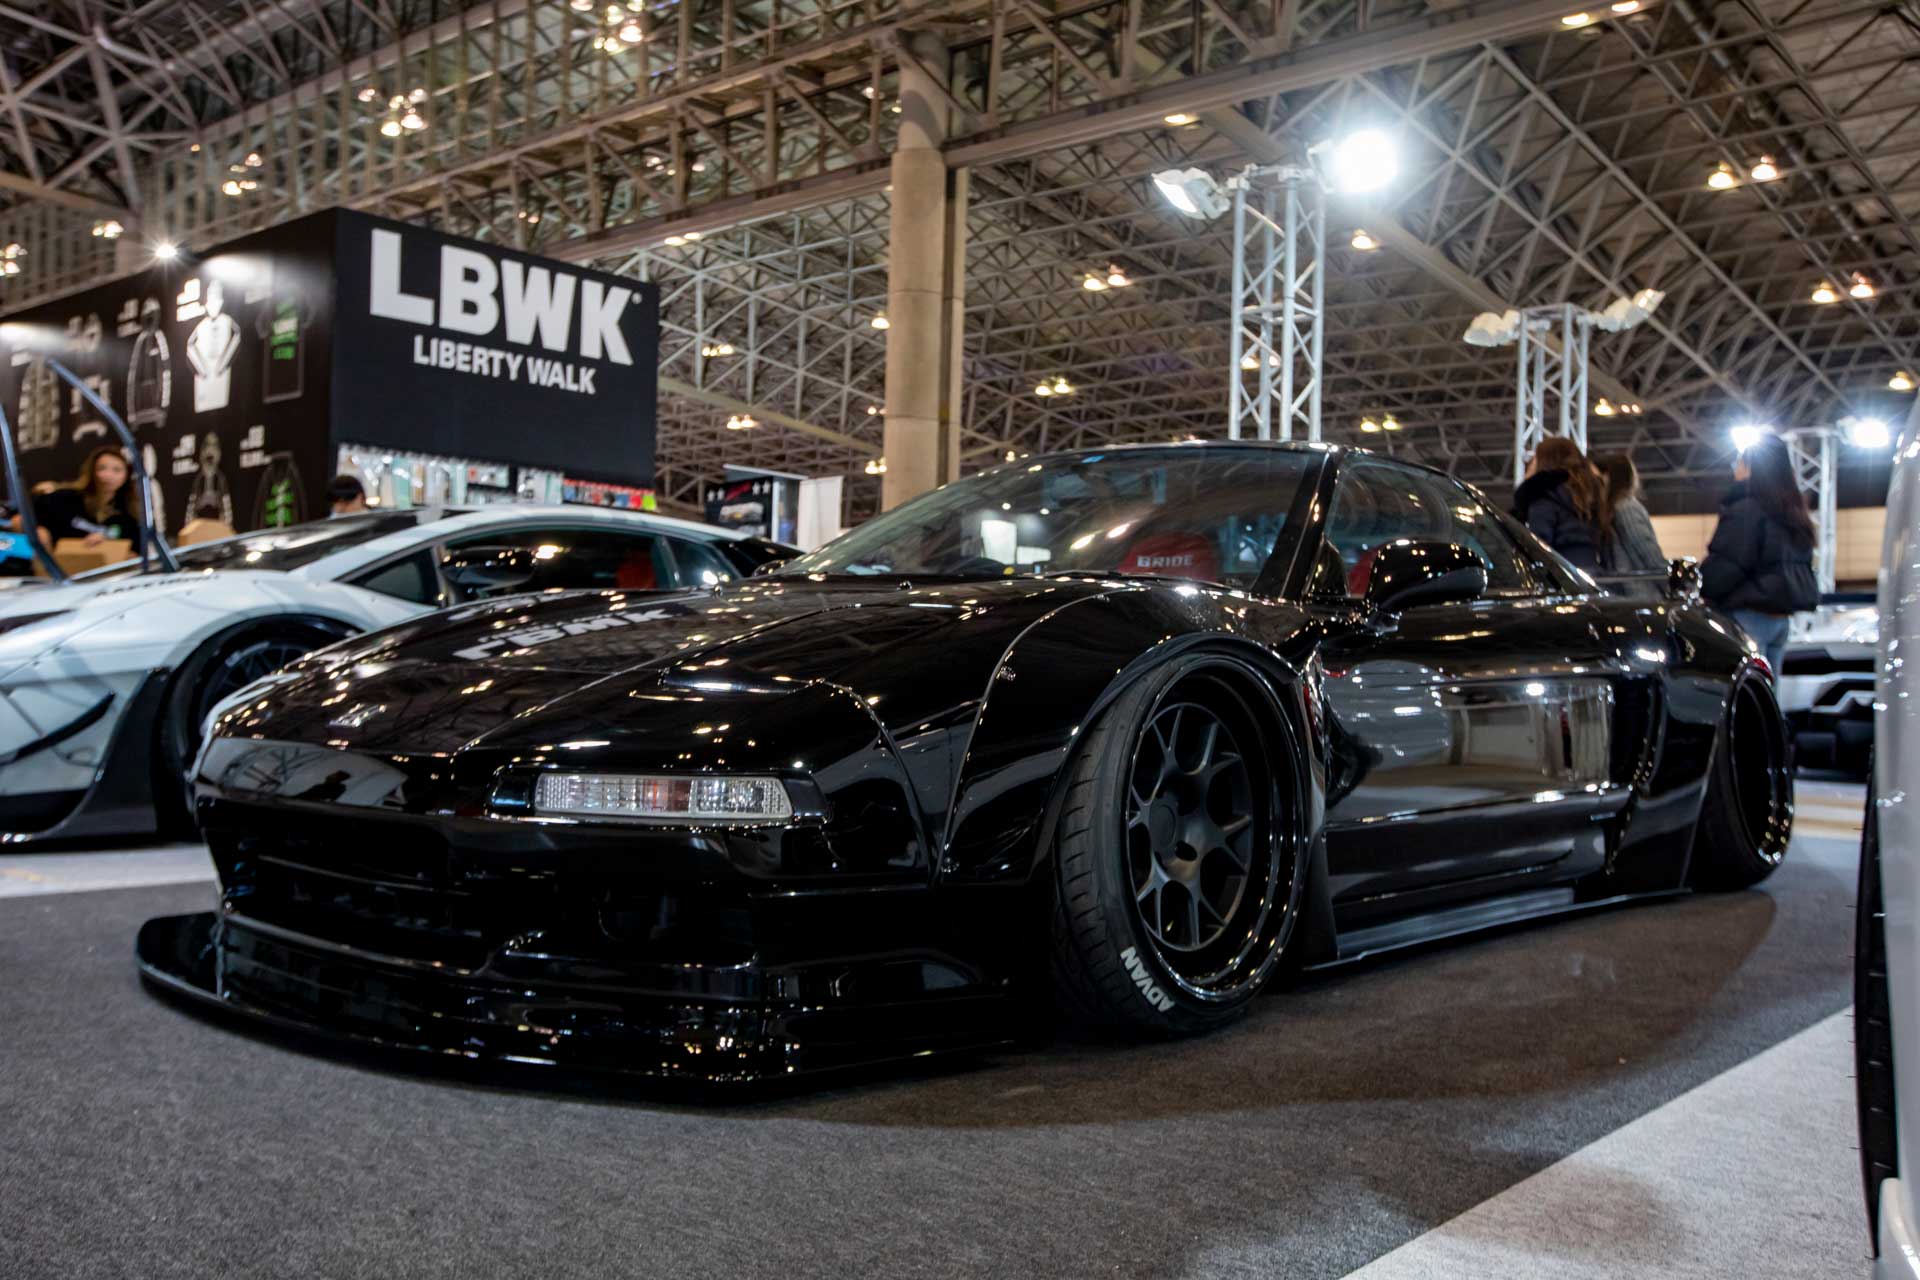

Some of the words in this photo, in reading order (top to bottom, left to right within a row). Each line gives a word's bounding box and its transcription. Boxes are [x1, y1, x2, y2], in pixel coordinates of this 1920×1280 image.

[369, 228, 634, 366] LBWK
[413, 335, 523, 381] LIBERTY
[526, 356, 596, 394] WALK
[1136, 554, 1194, 568] BRIDE
[1120, 946, 1176, 1012] ADVAN
